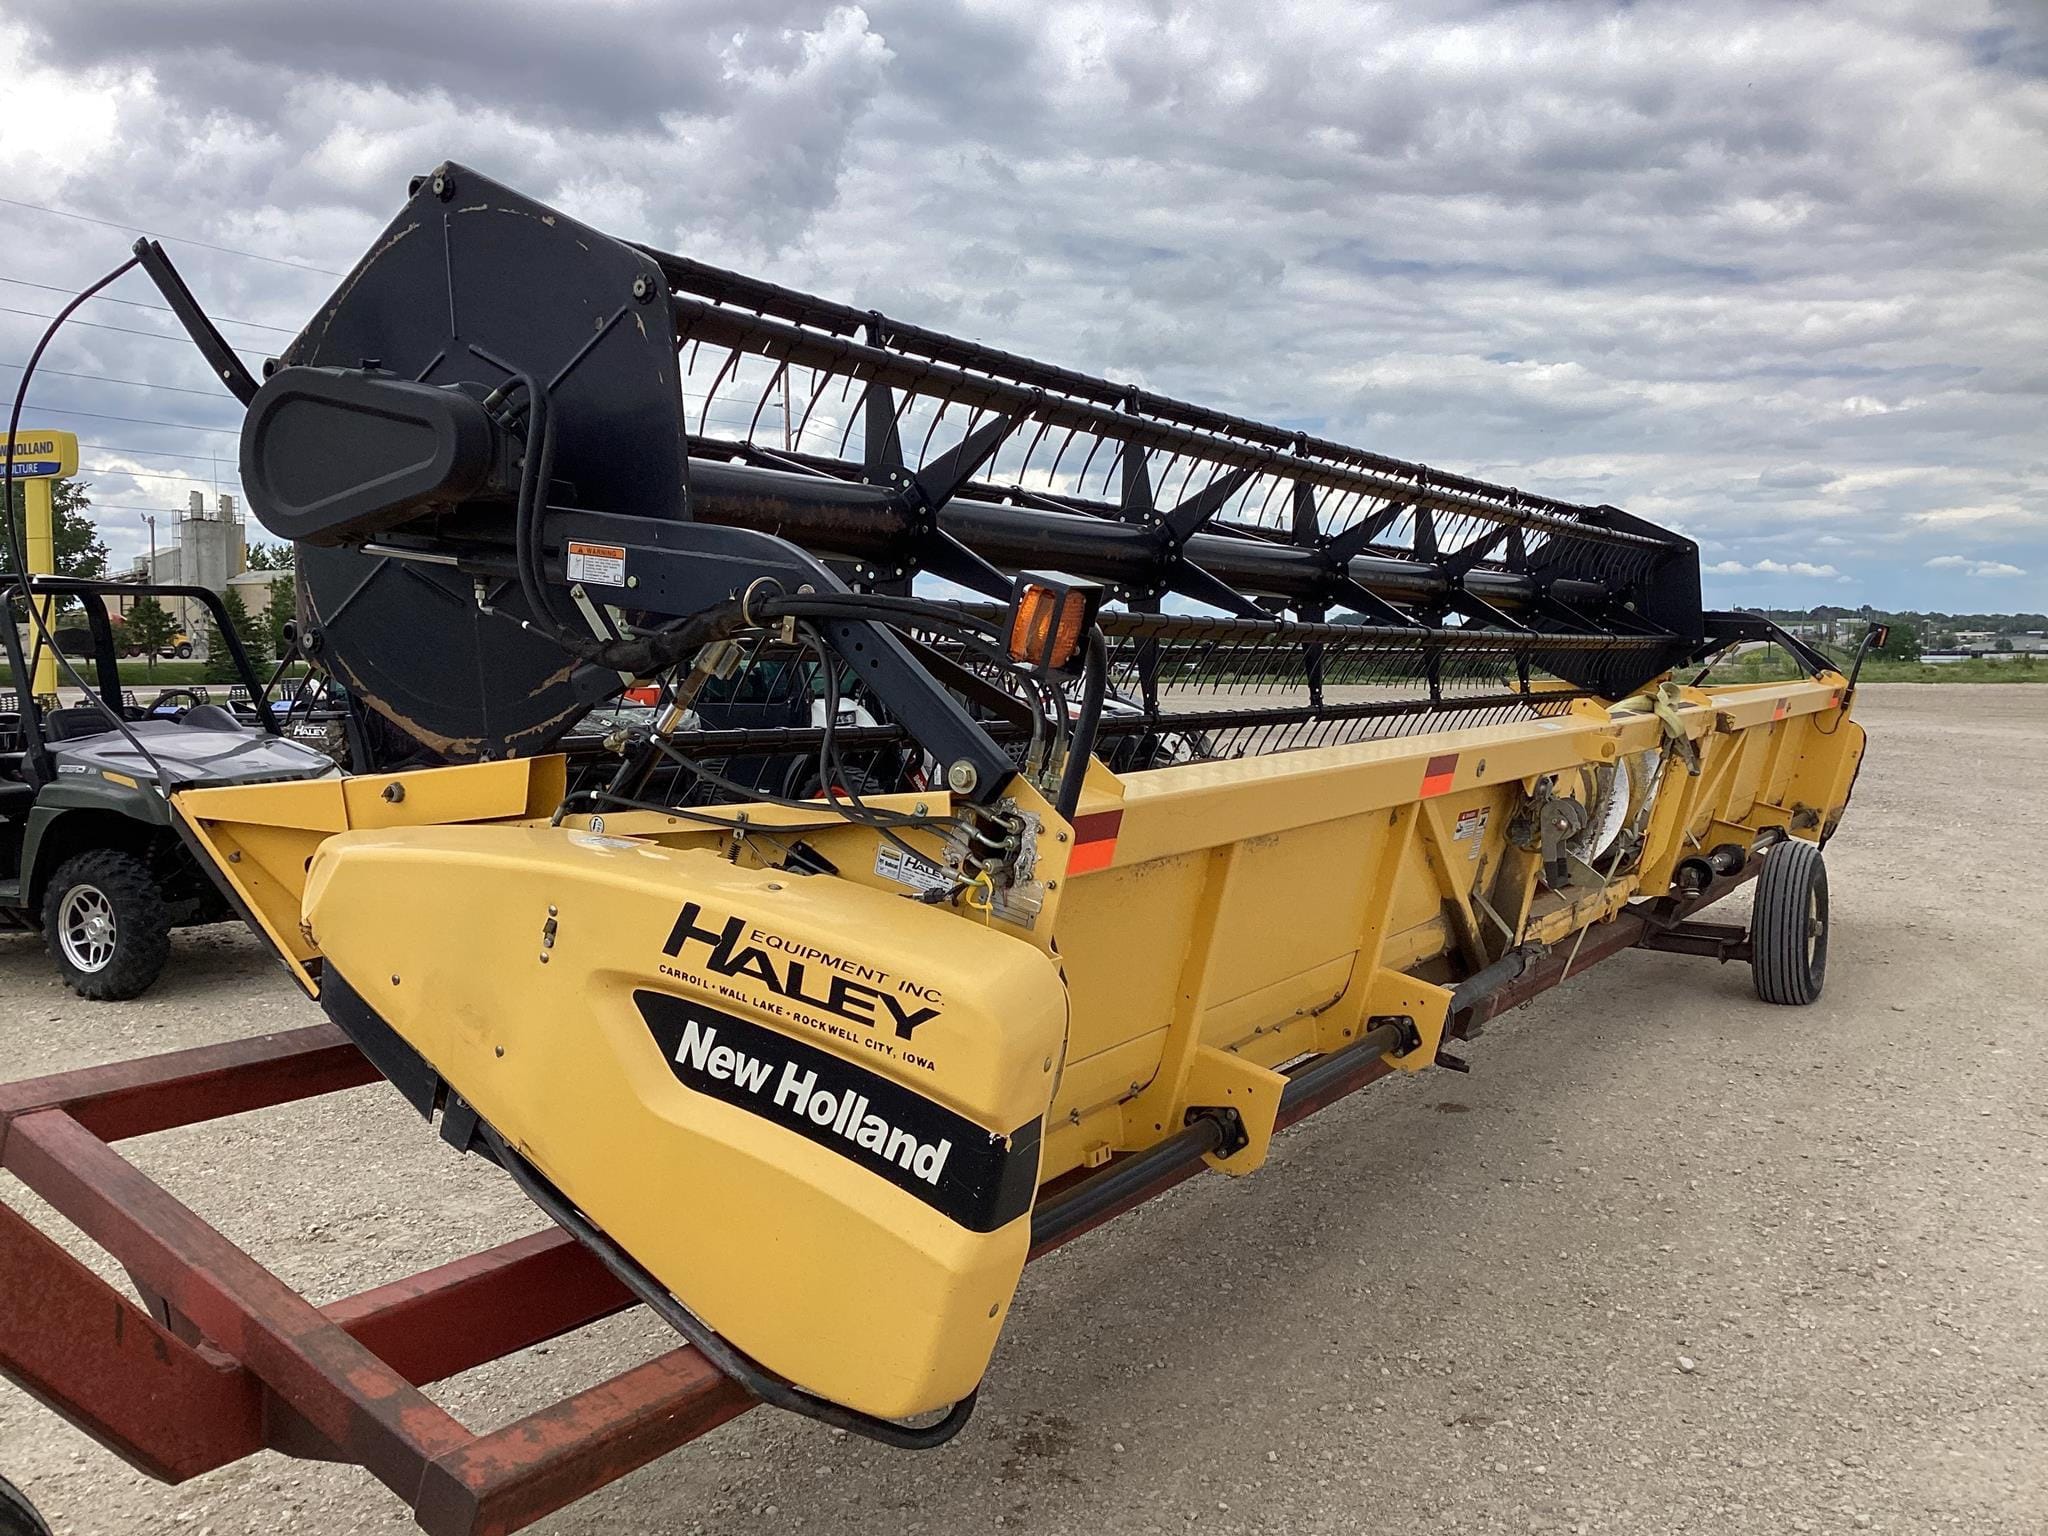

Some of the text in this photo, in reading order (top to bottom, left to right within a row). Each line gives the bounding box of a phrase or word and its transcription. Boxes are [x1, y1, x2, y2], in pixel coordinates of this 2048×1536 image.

[12, 441, 54, 456] OLLAND
[293, 725, 328, 736] HALEY
[661, 901, 942, 1041] HALEY
[750, 929, 945, 1006] EQUIPMENT INC.
[659, 964, 936, 1071] CARROLL WALL LAKE ROCKWELL CITY, IOWA
[674, 1019, 953, 1186] New Holland
